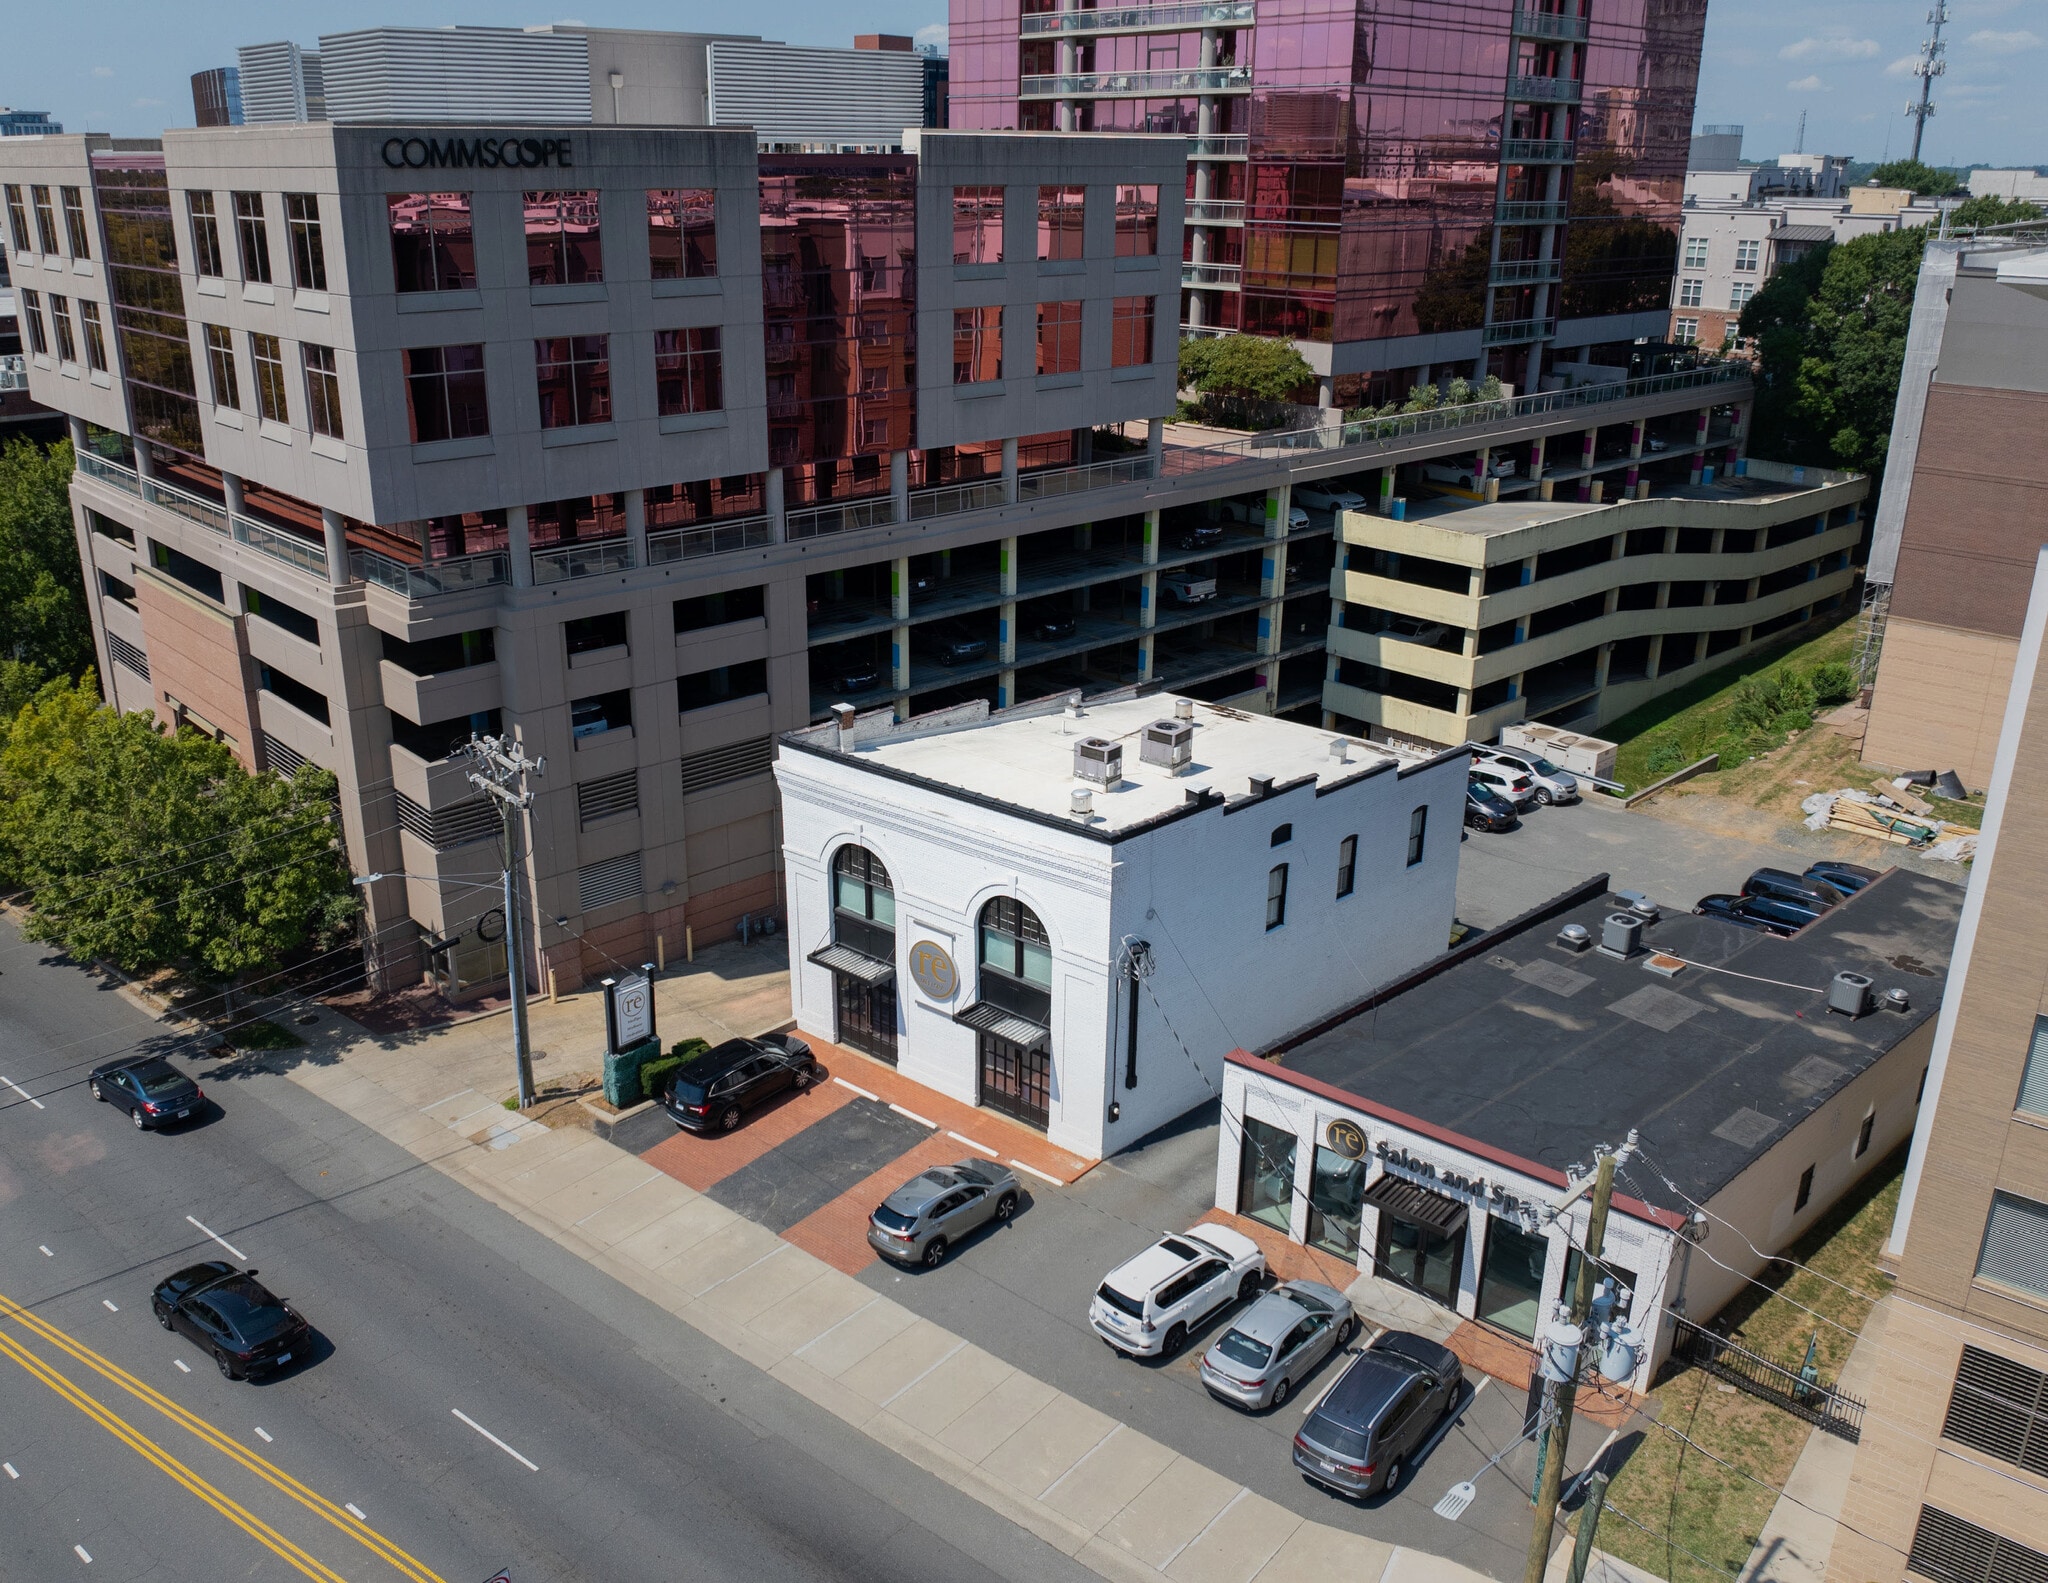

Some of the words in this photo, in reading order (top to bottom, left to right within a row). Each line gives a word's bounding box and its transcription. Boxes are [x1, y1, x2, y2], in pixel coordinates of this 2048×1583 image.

[381, 137, 572, 168] COMMSCOPE
[917, 950, 947, 983] re
[625, 996, 642, 1013] re
[1375, 1140, 1435, 1180] Salon
[1441, 1171, 1485, 1198] and
